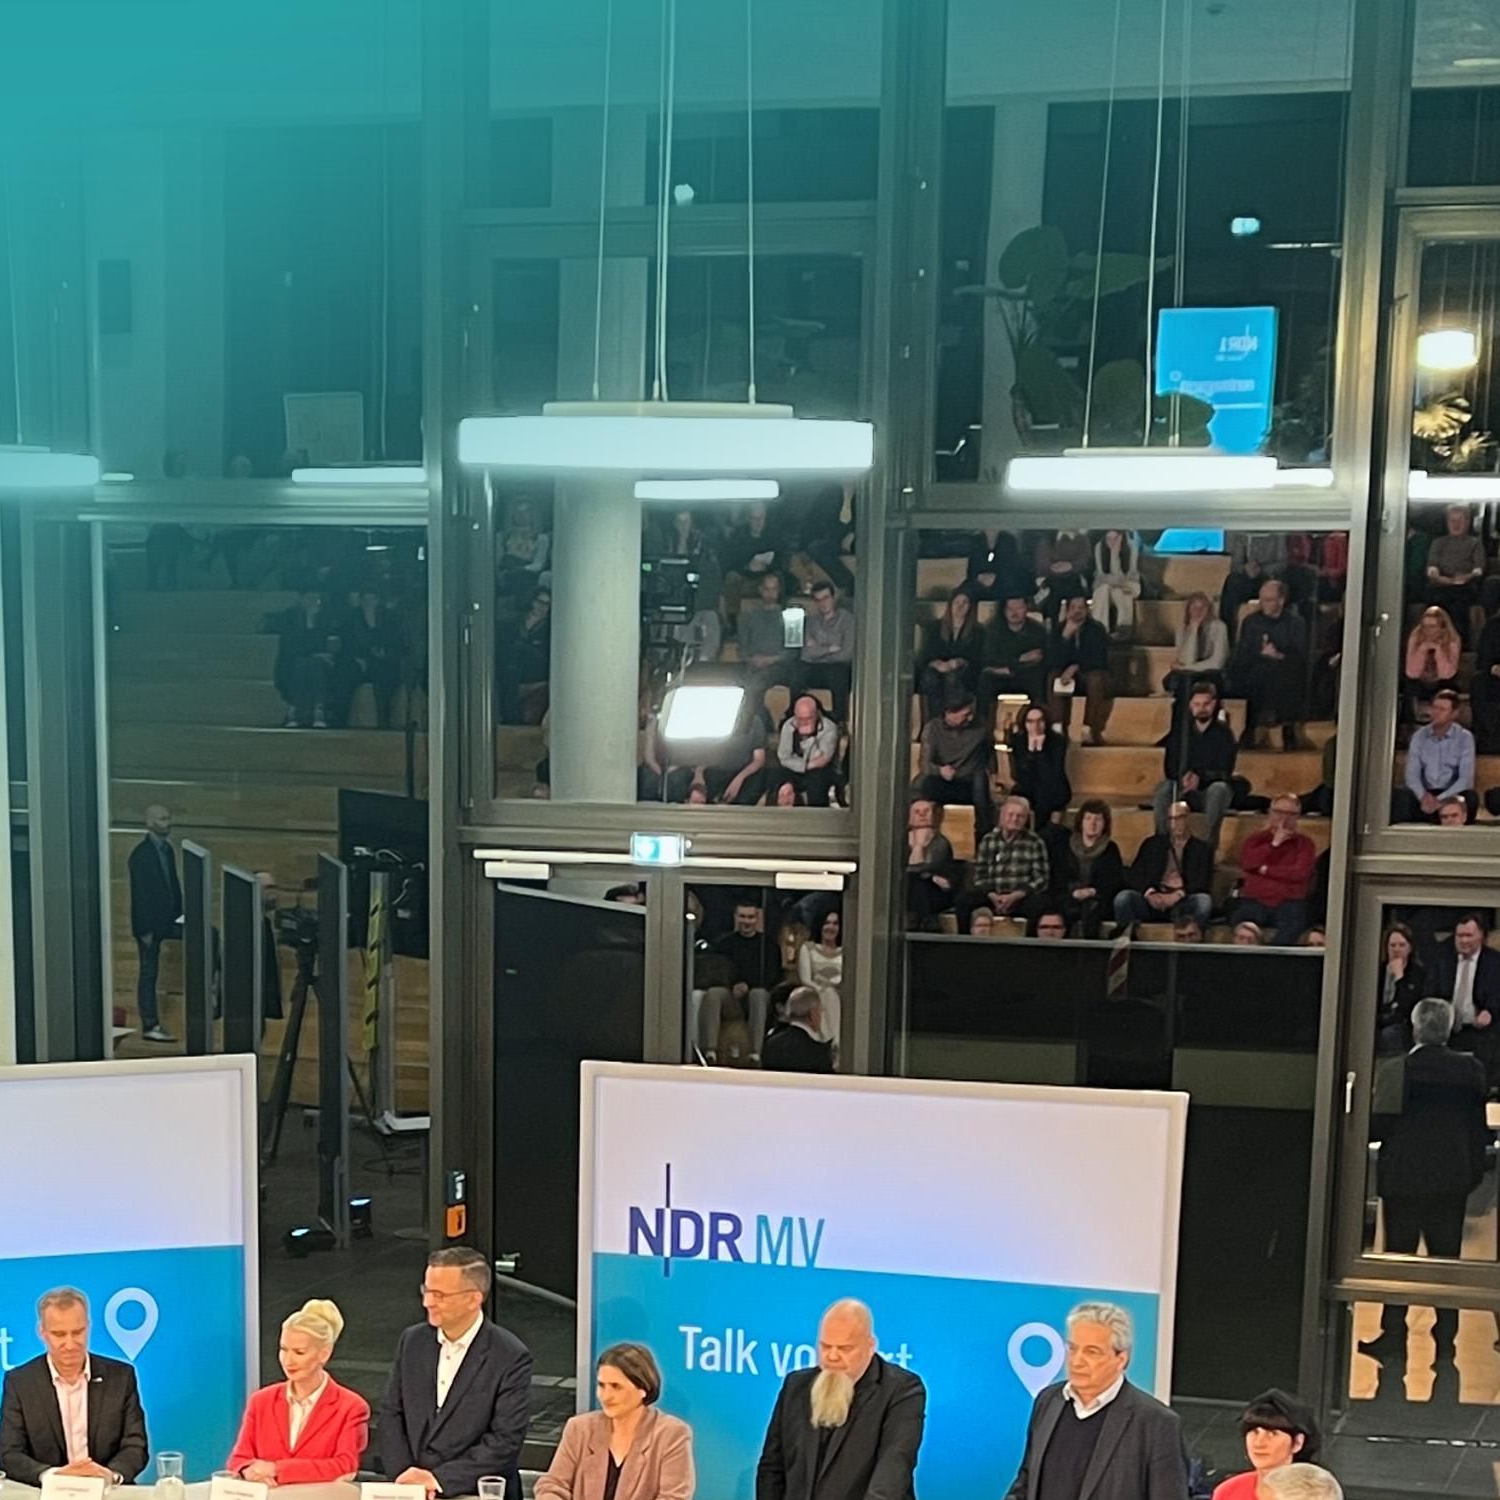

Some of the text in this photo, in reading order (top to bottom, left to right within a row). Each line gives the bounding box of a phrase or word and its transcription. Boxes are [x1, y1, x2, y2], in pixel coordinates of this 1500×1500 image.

[629, 1206, 825, 1268] NDR MV
[678, 1325, 759, 1376] Talk
